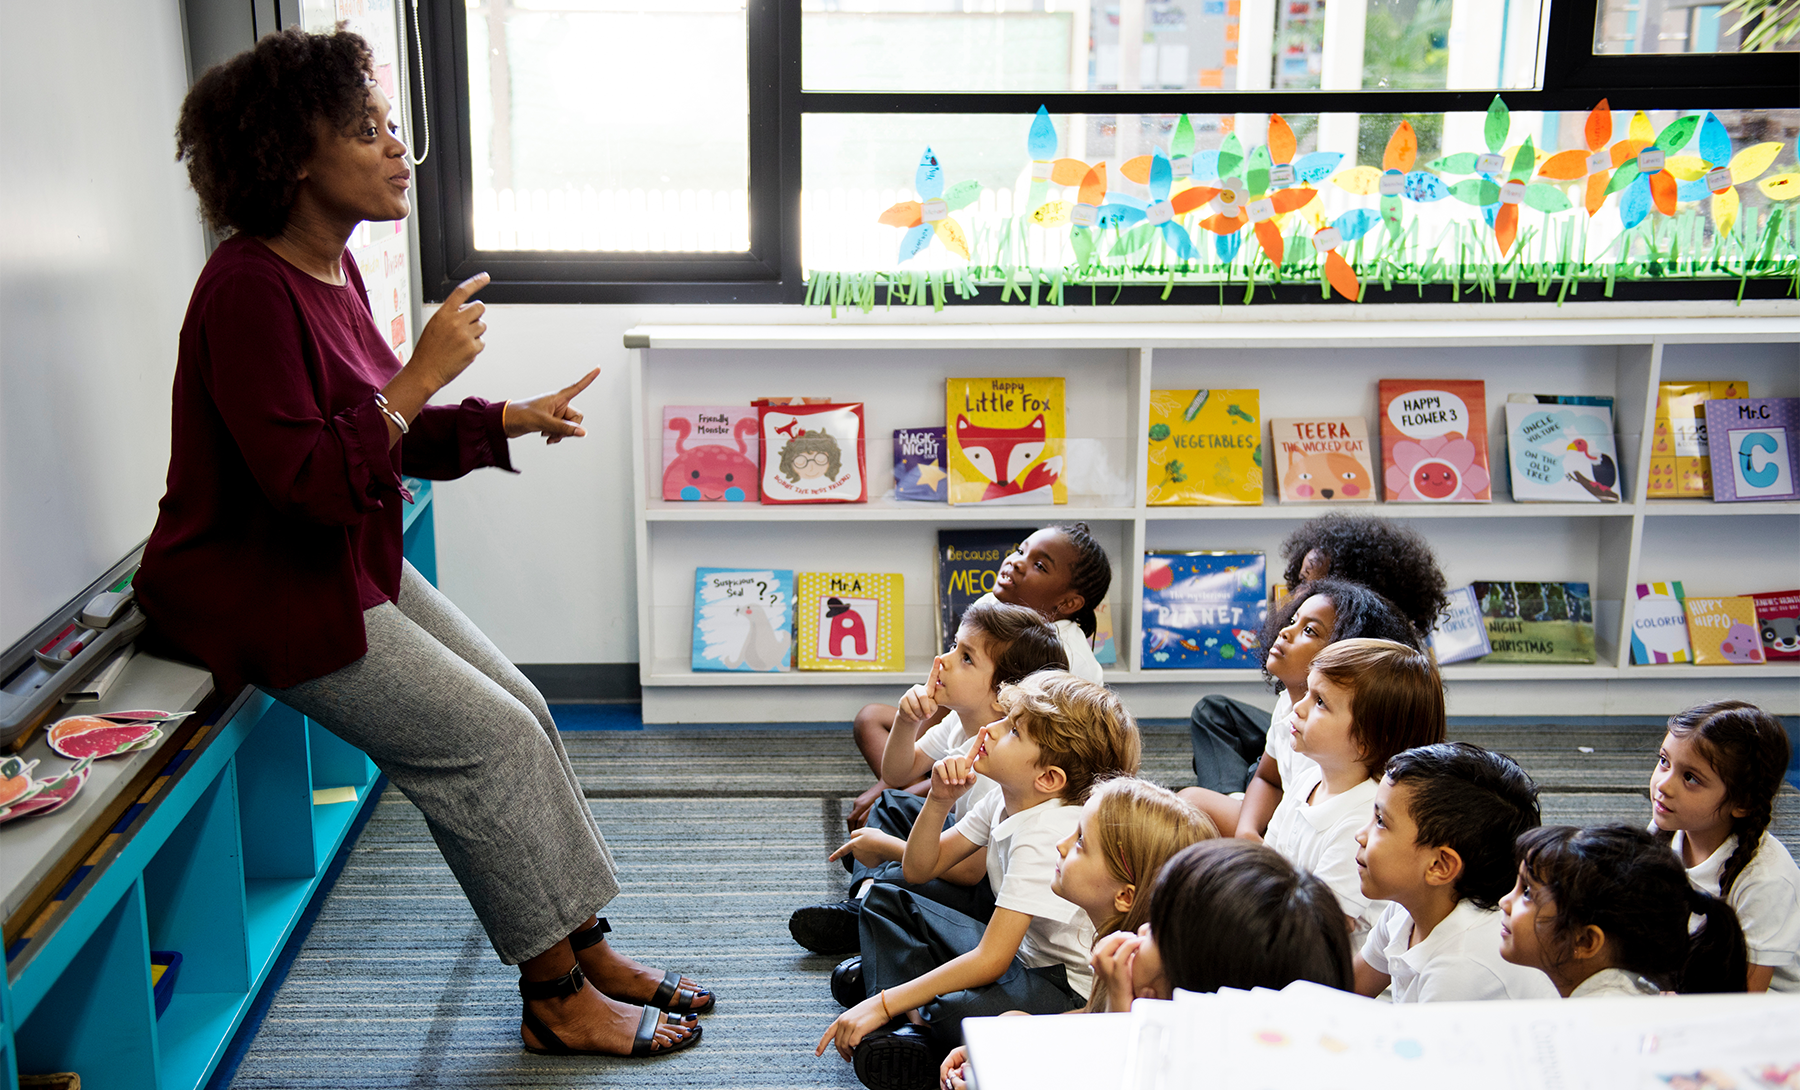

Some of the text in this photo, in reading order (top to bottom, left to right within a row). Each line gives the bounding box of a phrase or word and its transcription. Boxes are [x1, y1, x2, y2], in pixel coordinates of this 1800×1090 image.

[992, 380, 1025, 394] Happy
[966, 391, 1051, 413] Little Fox
[1403, 396, 1441, 412] HAPPY
[698, 413, 729, 426] Friendly
[1401, 408, 1458, 427] FLOWER 3
[1738, 405, 1771, 420] Mr.C
[697, 425, 729, 434] Monster
[1293, 422, 1351, 440] TEERA
[1522, 414, 1554, 435] UNCLE
[899, 432, 936, 445] MAGIC
[1526, 422, 1561, 443] VULTURE
[1172, 434, 1254, 449] VEGETABLES
[1281, 440, 1364, 453] THE WICKED CAT
[902, 443, 940, 456] NIGHT
[1524, 450, 1557, 466] ON THE
[1529, 461, 1550, 473] OLD
[1525, 468, 1551, 482] TREE
[947, 545, 1000, 561] Because
[713, 577, 755, 588] Suspicious
[831, 579, 862, 592] Mr.A
[947, 569, 999, 596] MEO
[727, 588, 744, 598] Seal
[1170, 590, 1231, 602] The mysterious
[1689, 599, 1723, 616] HIPPY
[1158, 605, 1243, 628] PLANET
[1635, 616, 1685, 629] COLORFU
[1694, 613, 1731, 629] HIPPO
[1489, 621, 1523, 634] NIGHT
[1491, 640, 1554, 654] CHRISTMAS
